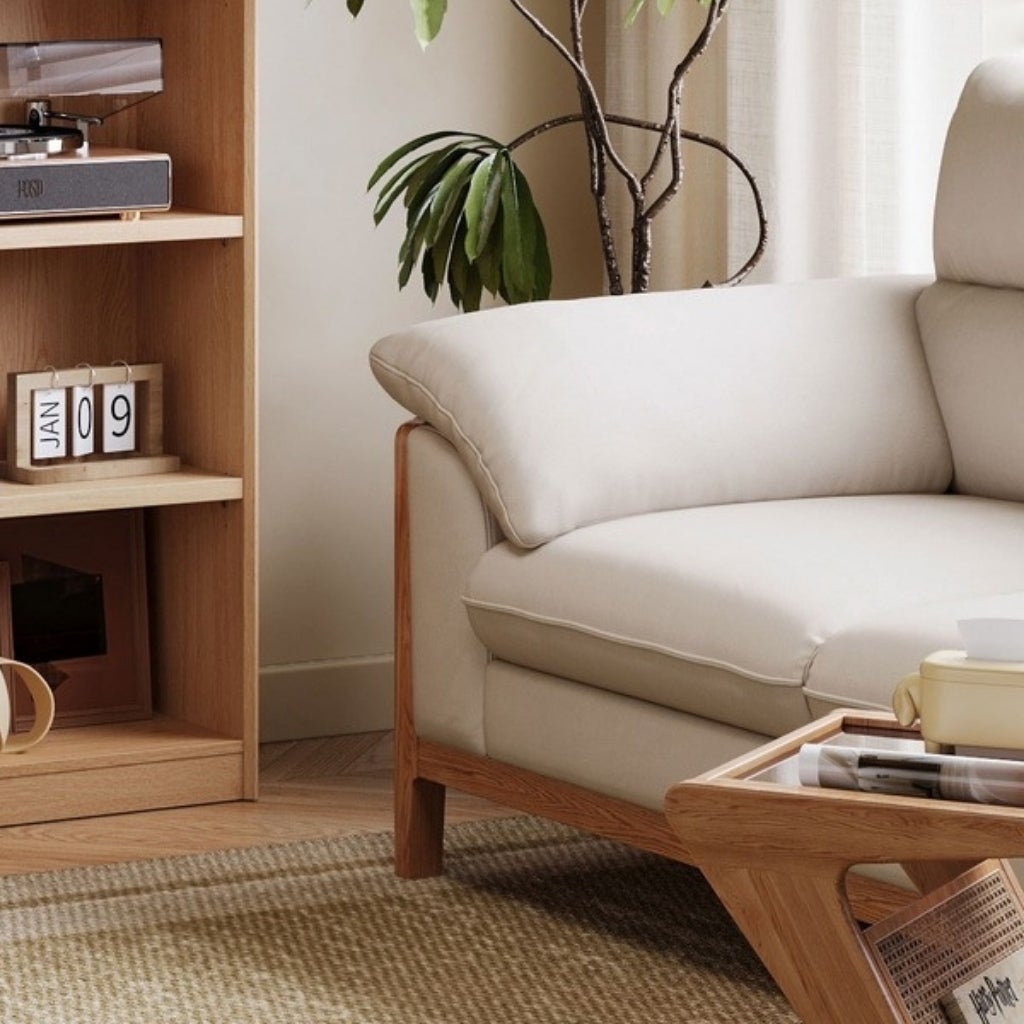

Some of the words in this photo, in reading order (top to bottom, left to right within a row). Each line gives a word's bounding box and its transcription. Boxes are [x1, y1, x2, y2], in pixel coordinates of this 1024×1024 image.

[39, 401, 61, 448] JAN
[78, 396, 91, 440] 0
[110, 394, 131, 437] 9
